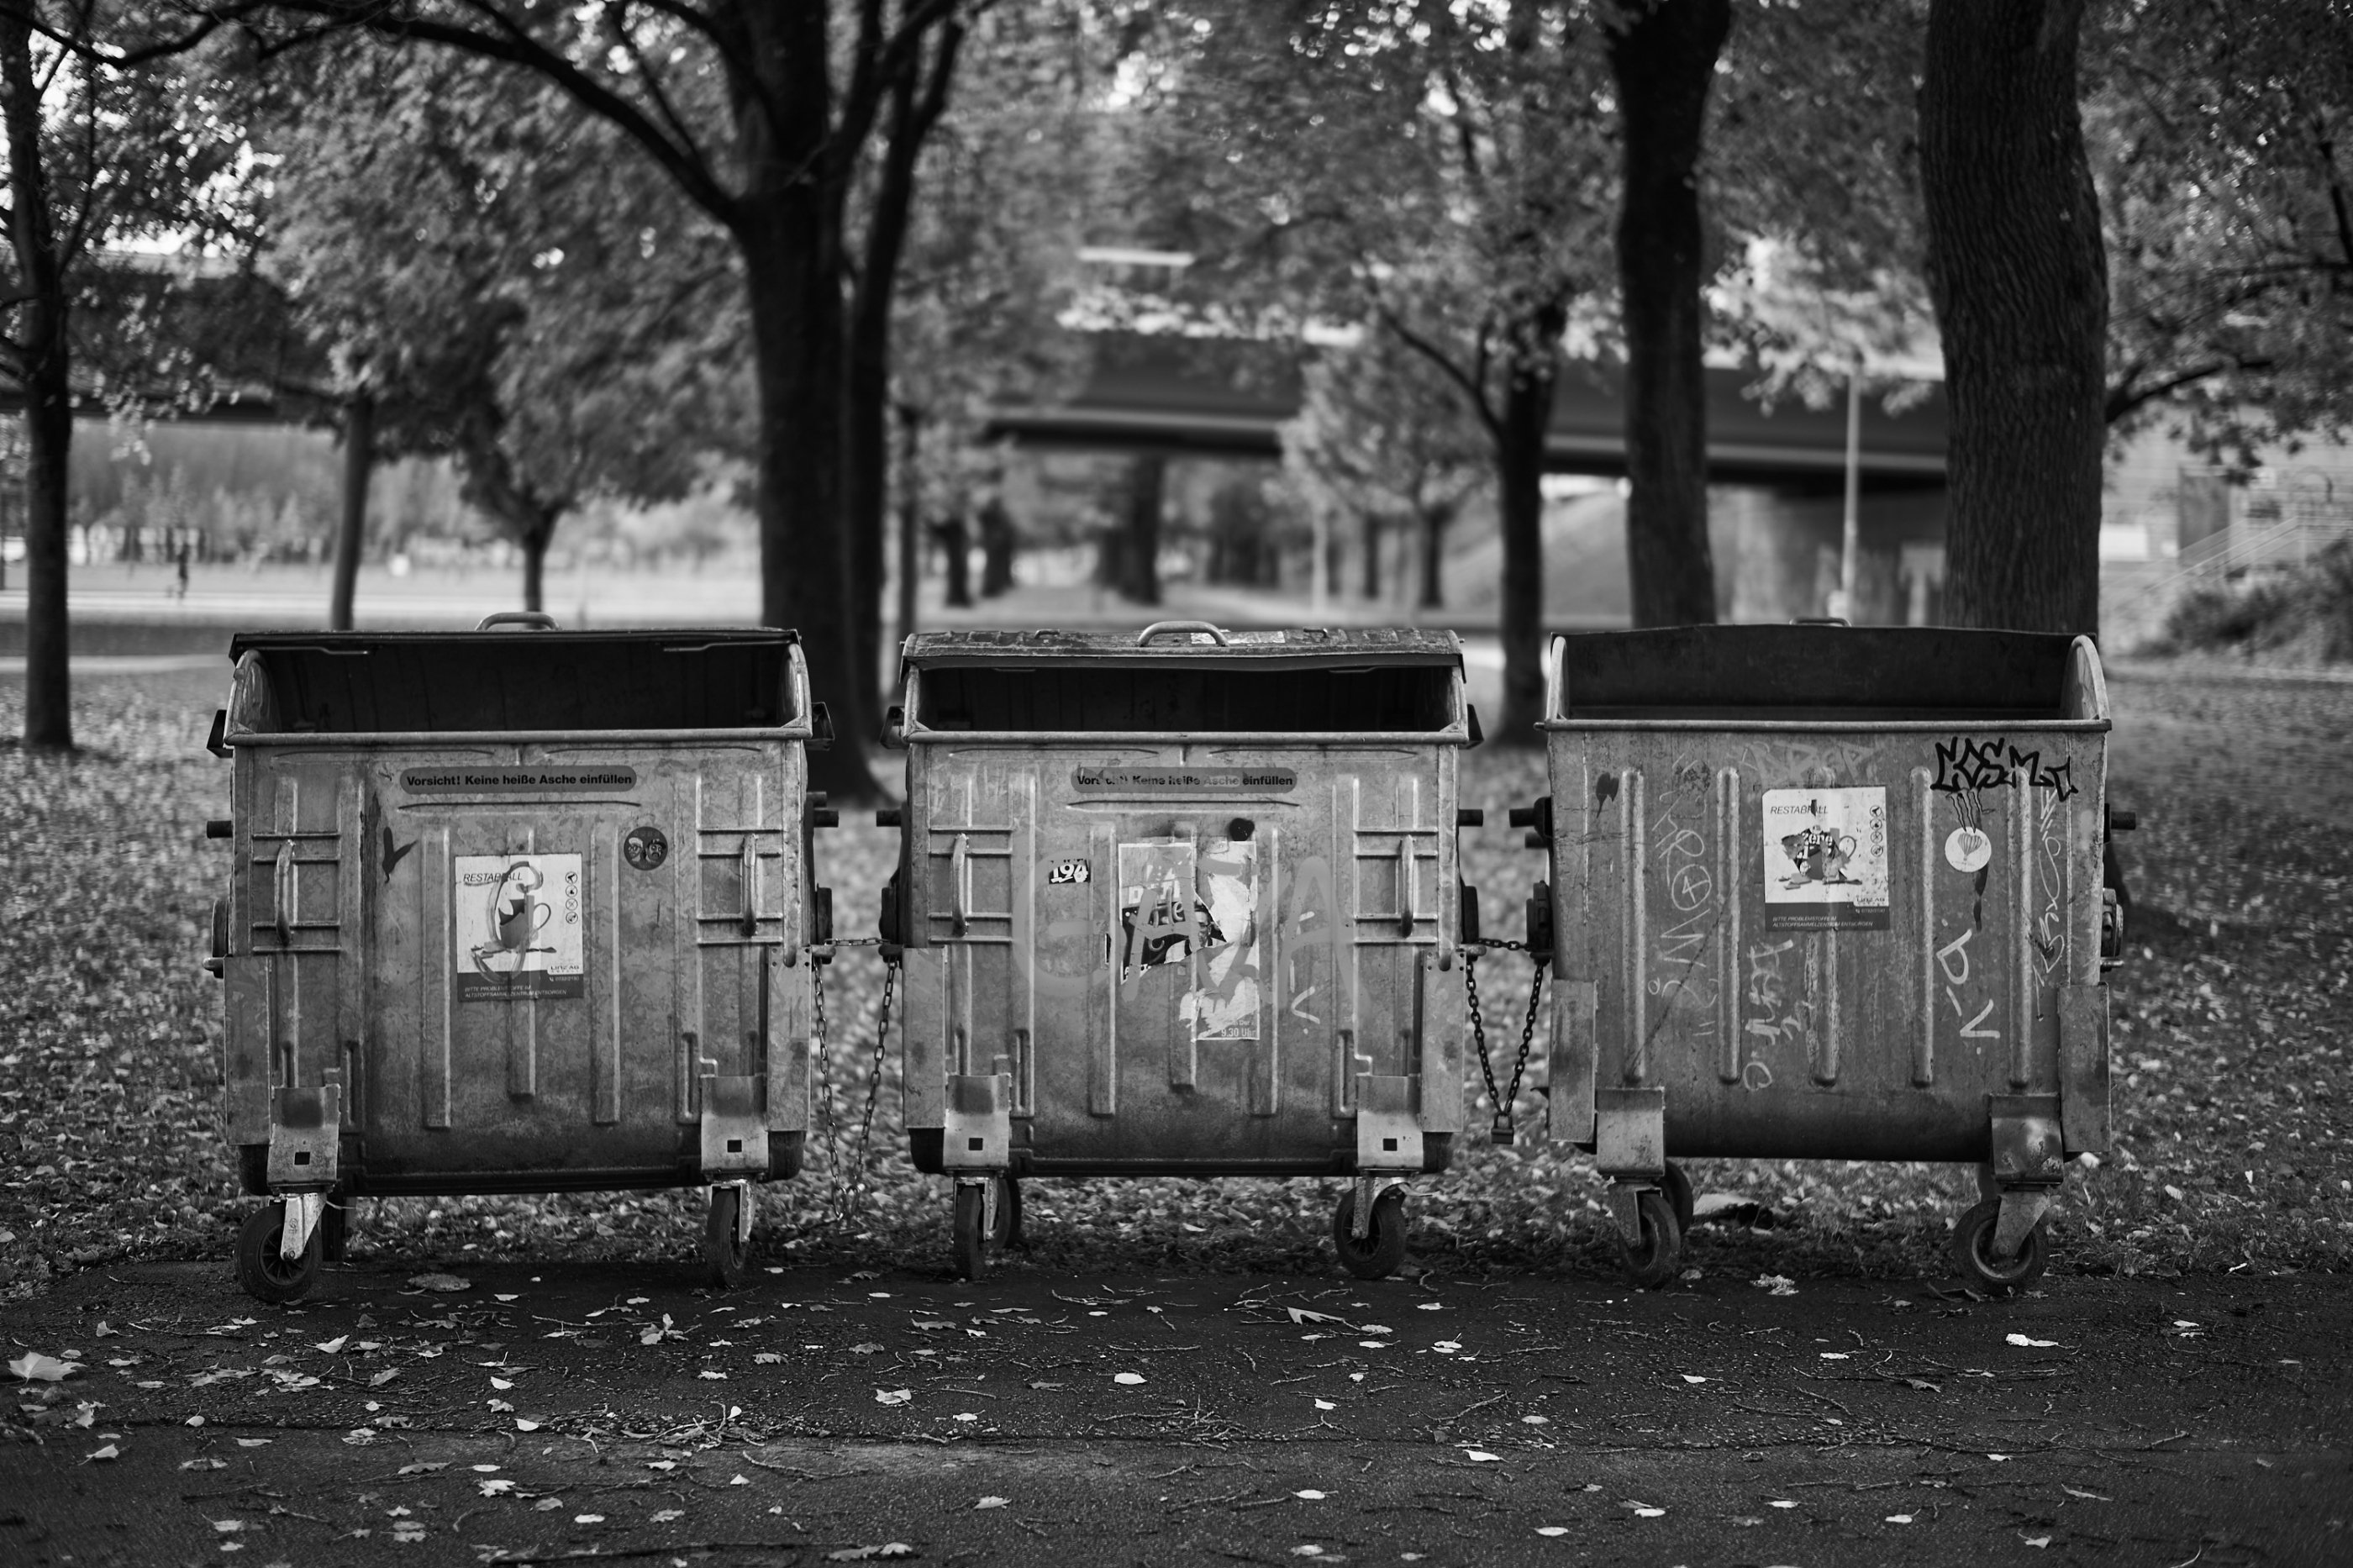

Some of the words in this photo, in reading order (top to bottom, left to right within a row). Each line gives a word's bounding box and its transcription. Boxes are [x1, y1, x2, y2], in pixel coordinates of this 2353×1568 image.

[407, 775, 461, 786] Vorsicht!
[465, 775, 499, 785] Keine
[503, 774, 535, 785] heiße
[539, 774, 576, 784] Asche
[579, 773, 632, 784] einfüllen
[1203, 775, 1240, 785] Asche
[1242, 775, 1293, 786] einfüllen
[1241, 1027, 1256, 1037] Uhr
